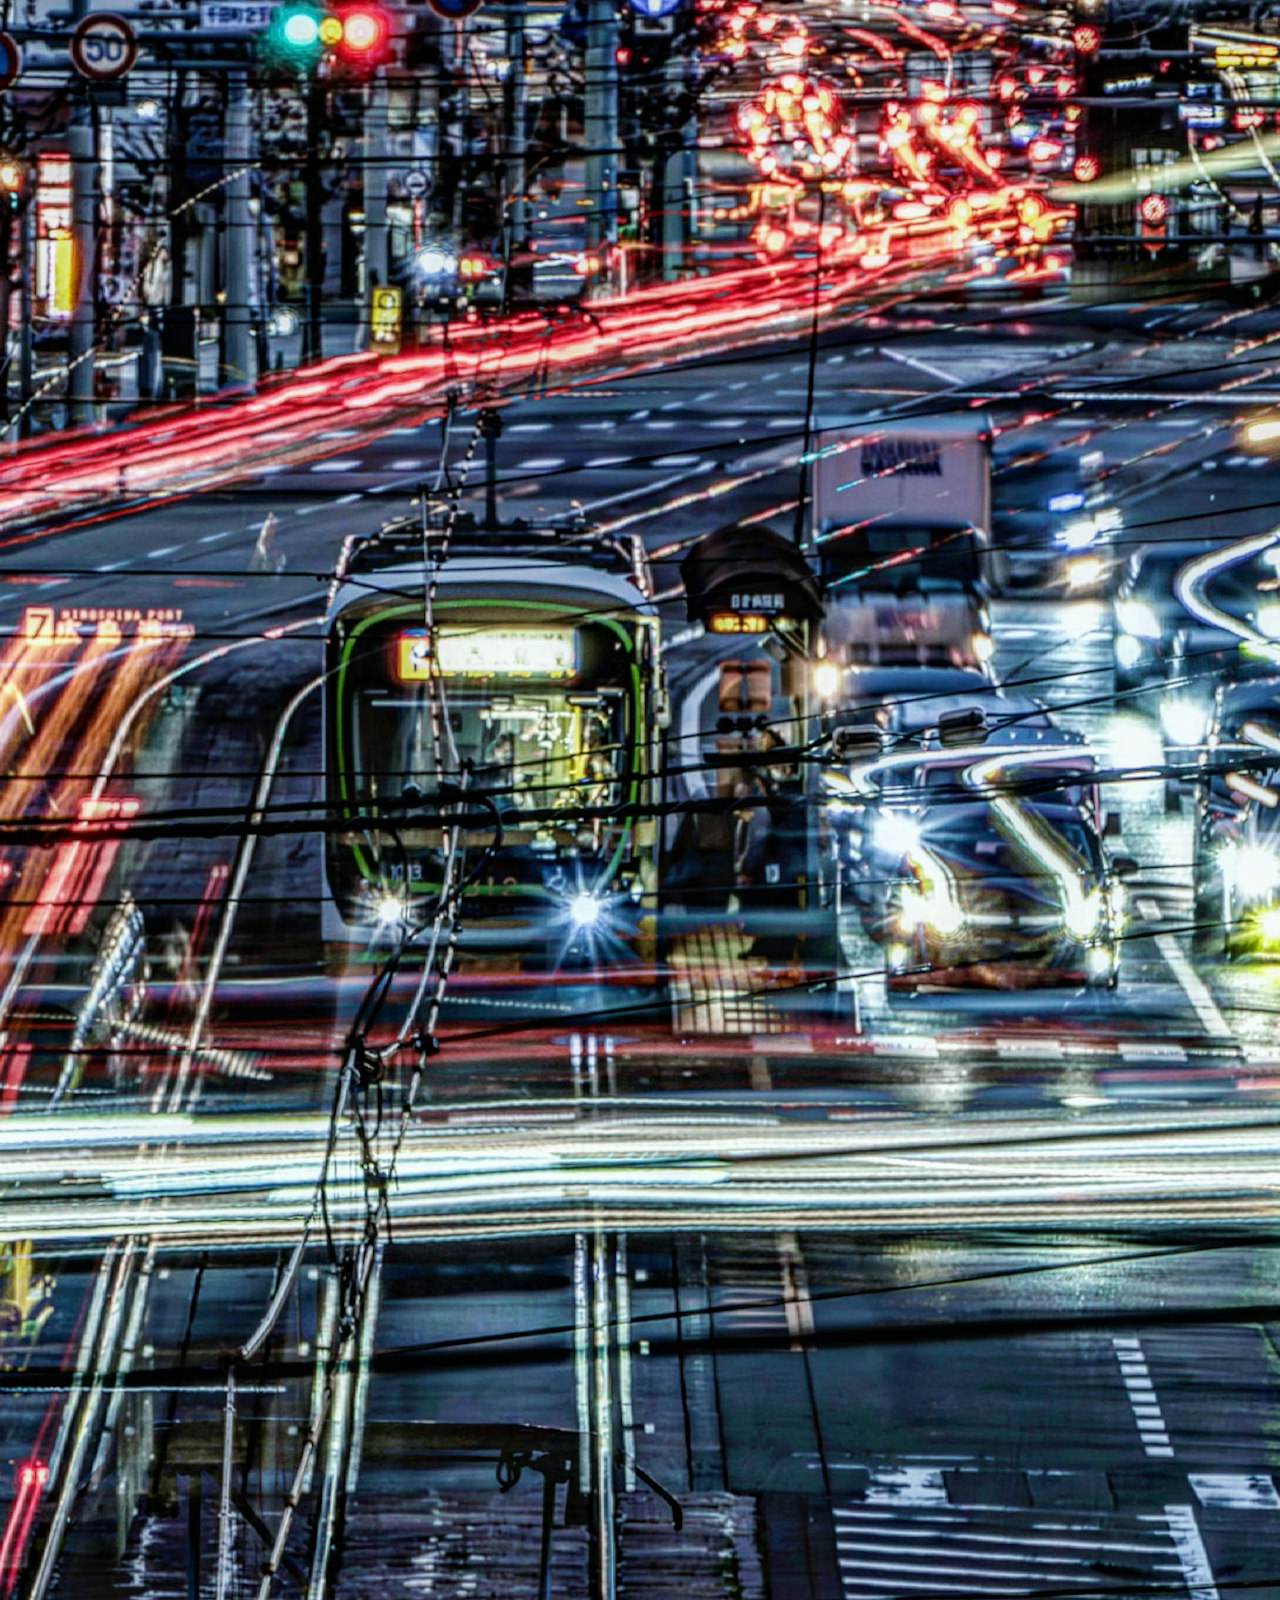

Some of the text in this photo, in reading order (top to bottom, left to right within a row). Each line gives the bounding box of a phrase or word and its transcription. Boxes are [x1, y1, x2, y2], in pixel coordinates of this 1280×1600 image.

[86, 32, 124, 62] 50
[29, 609, 183, 640] 7 HIROSHIMA PORT
